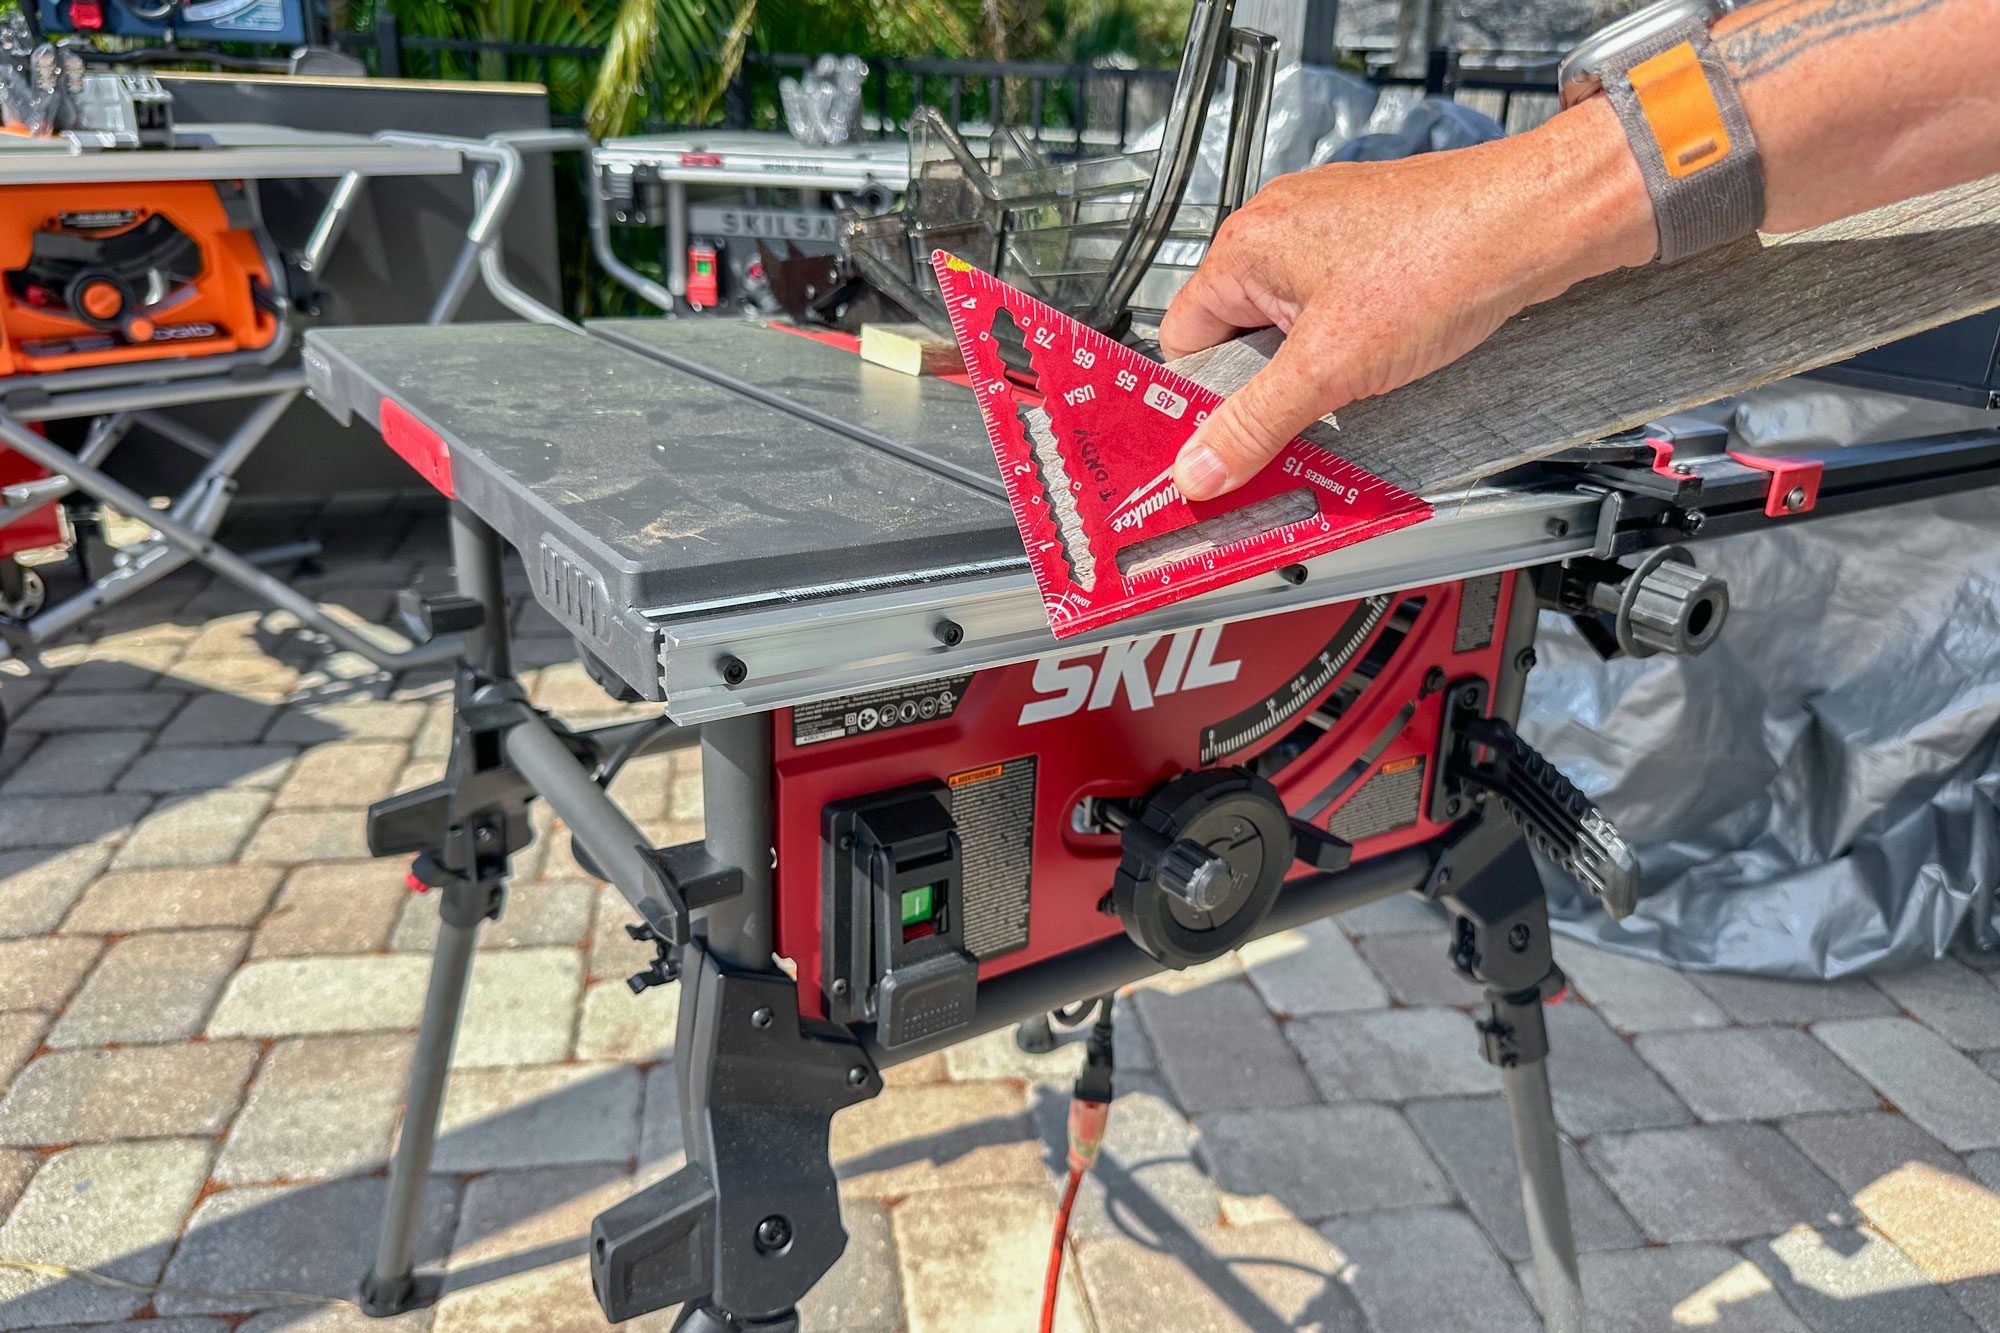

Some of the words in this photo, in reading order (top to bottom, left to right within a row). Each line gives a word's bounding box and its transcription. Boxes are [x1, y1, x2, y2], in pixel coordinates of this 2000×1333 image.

[722, 213, 833, 239] SKILSA
[961, 297, 977, 310] 4
[1033, 326, 1056, 350] 75
[1072, 347, 1096, 370] 65
[988, 381, 1005, 395] 3
[1114, 369, 1138, 393] 55
[1063, 384, 1096, 407] USA
[1154, 390, 1176, 411] 45
[1014, 462, 1031, 476] 2
[1282, 456, 1304, 477] 15
[1304, 468, 1345, 496] DEGREES
[1344, 487, 1359, 505] 5
[1039, 541, 1055, 553] 1
[1287, 533, 1295, 543] 3
[1207, 559, 1215, 570] 2
[1070, 593, 1092, 608] PIVOT
[1128, 586, 1135, 596] 1
[1018, 624, 1242, 727] SKIL
